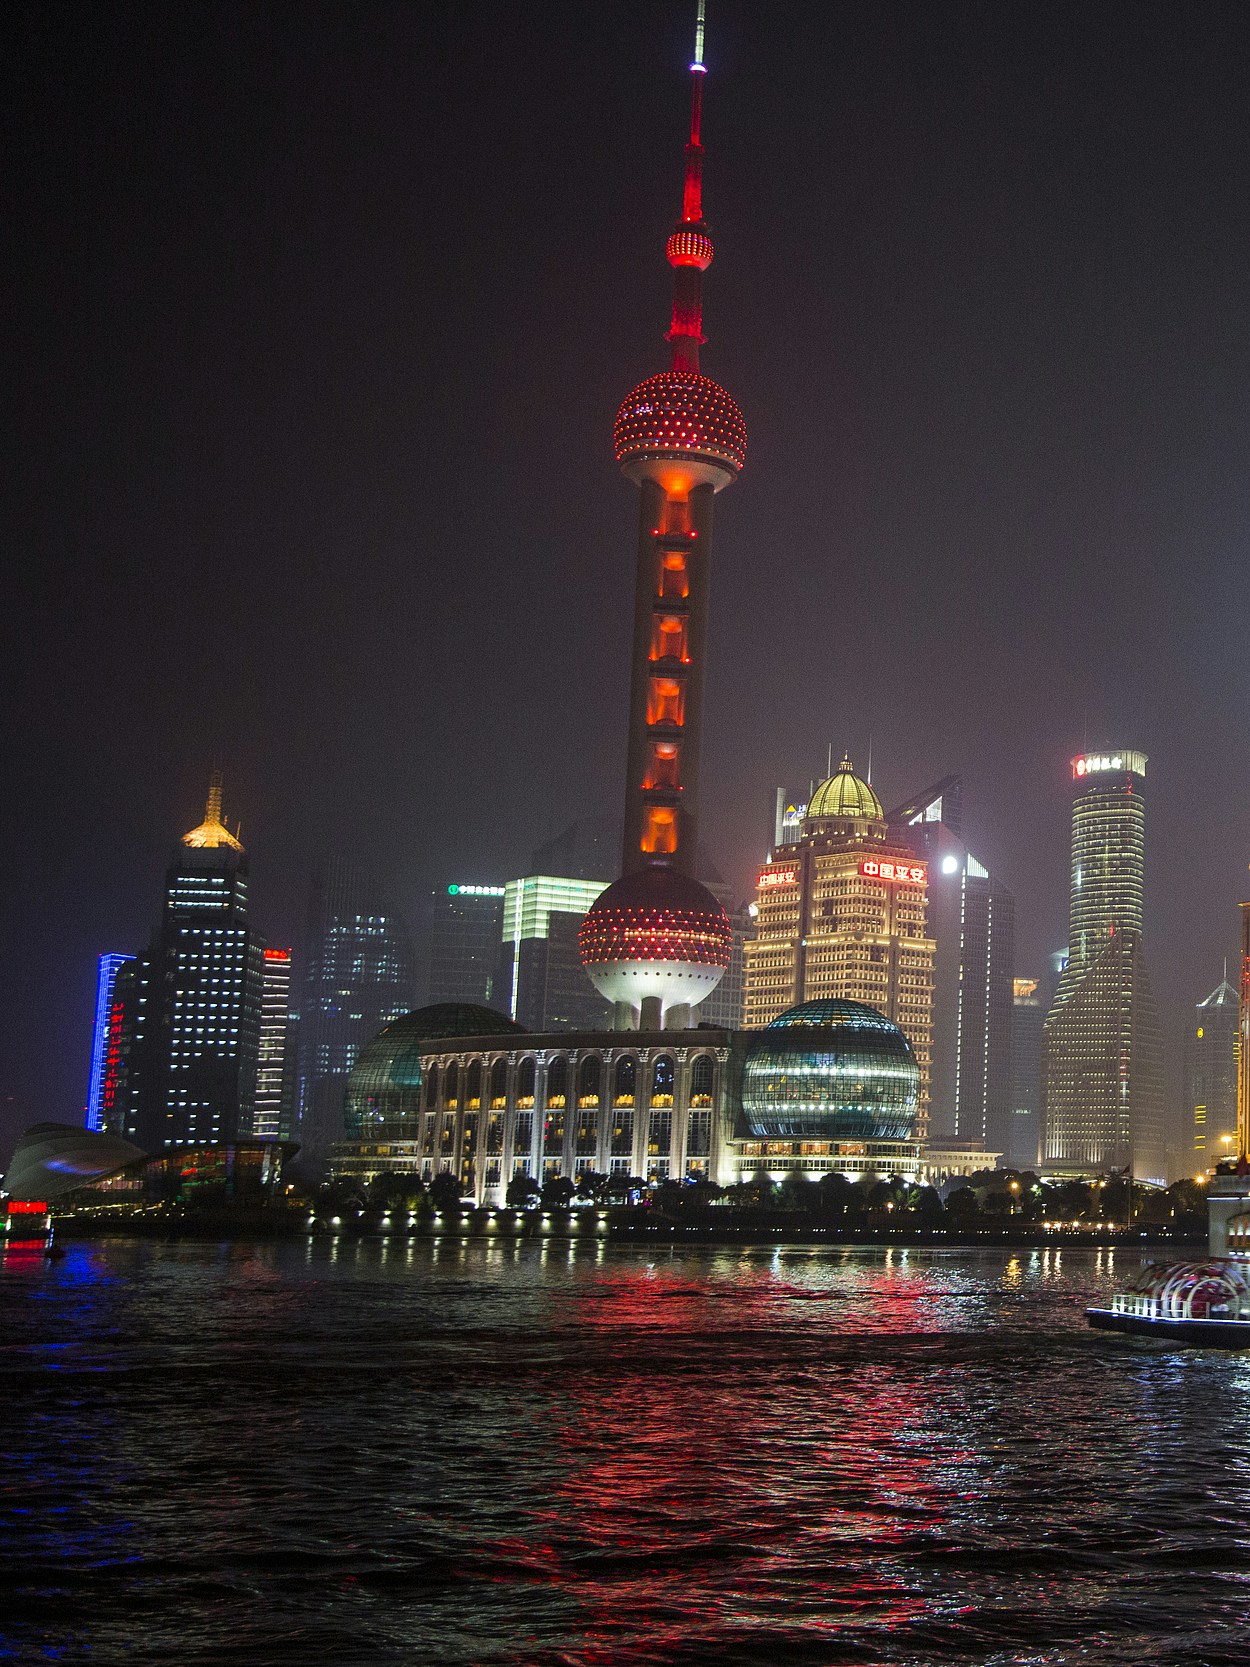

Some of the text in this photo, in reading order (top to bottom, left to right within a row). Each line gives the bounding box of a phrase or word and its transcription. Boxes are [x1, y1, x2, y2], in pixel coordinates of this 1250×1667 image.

[759, 872, 796, 887] 中国平安
[863, 860, 925, 884] 中国平安
